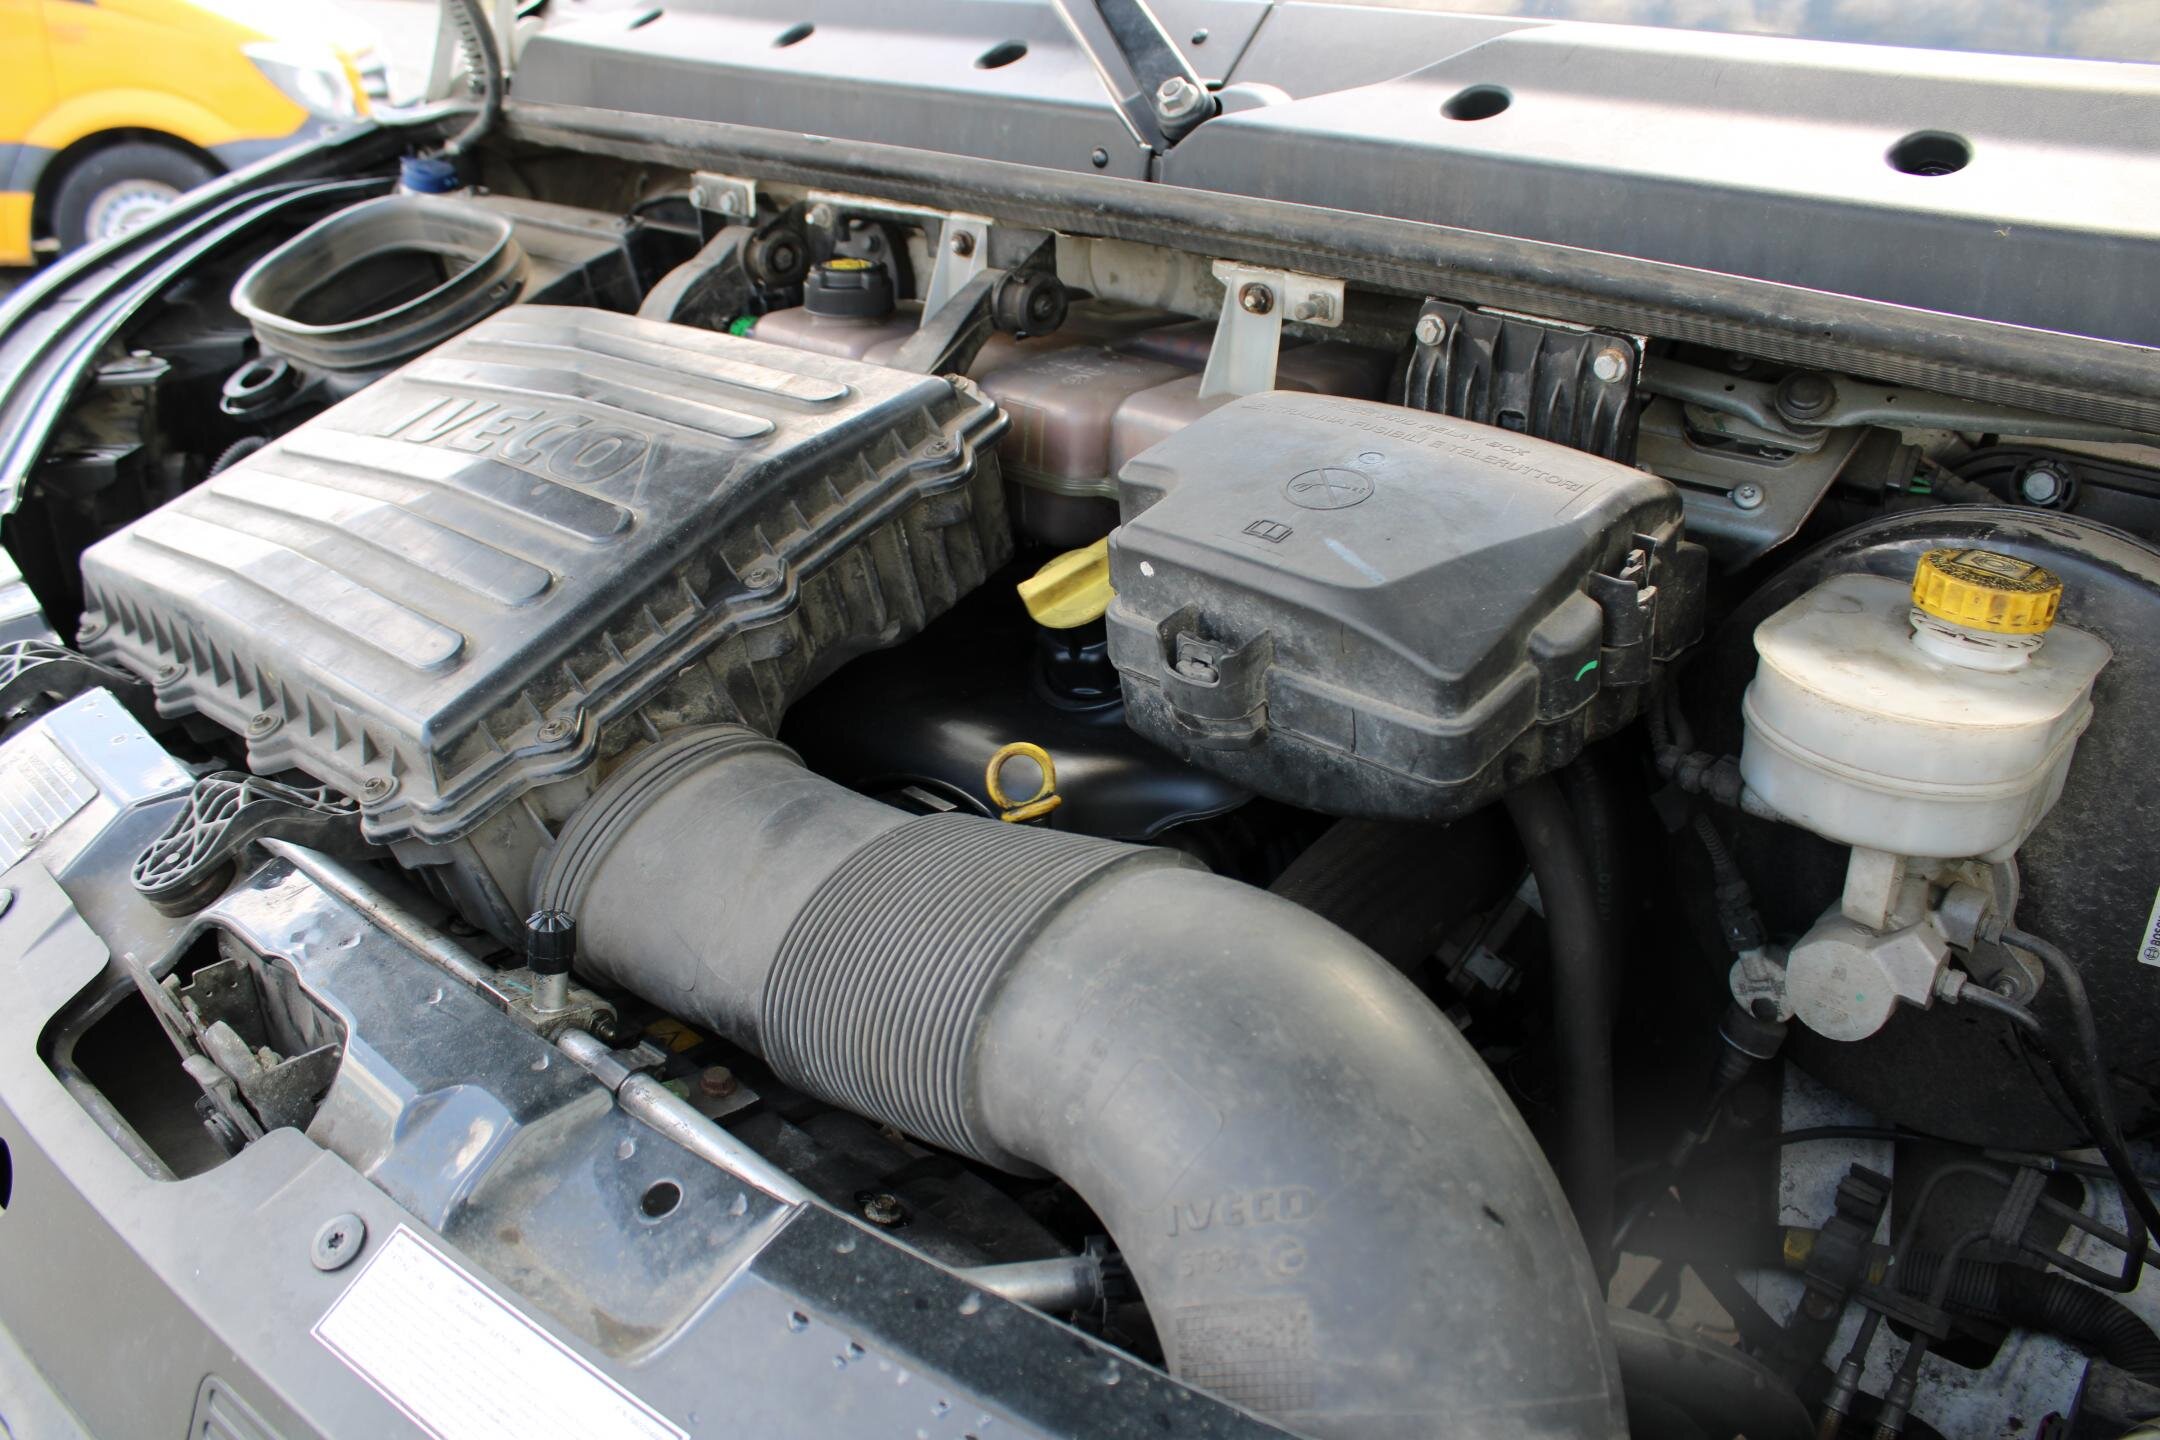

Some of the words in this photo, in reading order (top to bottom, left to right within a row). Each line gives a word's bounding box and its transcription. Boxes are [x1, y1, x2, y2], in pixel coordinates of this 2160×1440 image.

[375, 397, 650, 484] IVECO
[1350, 420, 1427, 445] FUSIBILI
[1429, 440, 1446, 449] E
[1449, 444, 1585, 492] TELERUTTORI
[1419, 424, 1483, 443] RELAY
[1486, 441, 1531, 457] BOX
[1167, 1186, 1314, 1238] IVECO
